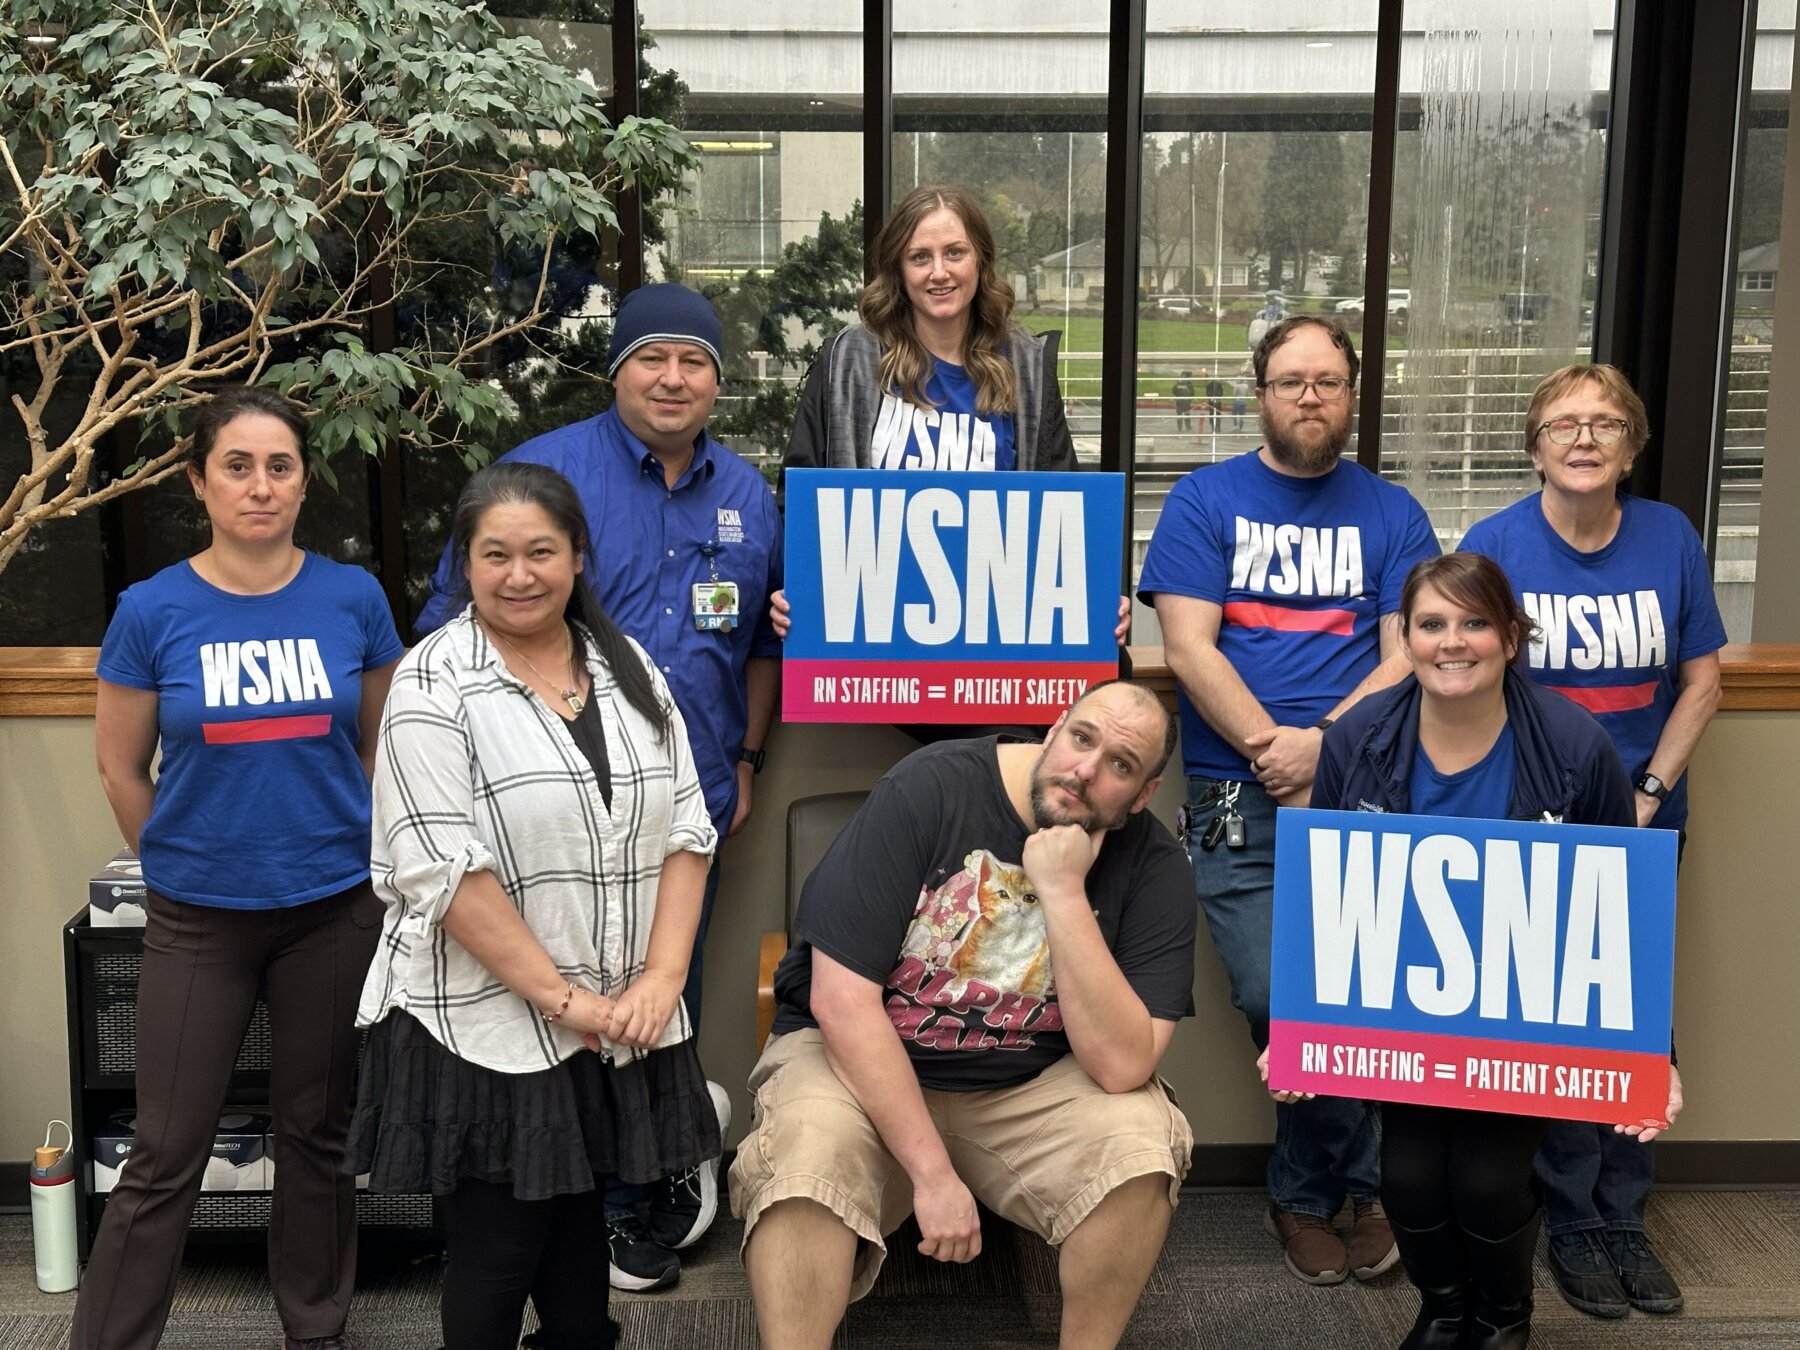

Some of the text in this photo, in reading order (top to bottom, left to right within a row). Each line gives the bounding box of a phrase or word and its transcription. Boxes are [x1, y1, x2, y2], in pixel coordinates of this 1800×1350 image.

[871, 394, 996, 471] WSNA
[717, 507, 742, 526] WSNA
[816, 487, 1090, 645] WSNA
[1231, 515, 1363, 597] WSNA
[1522, 589, 1667, 670] WSNA
[200, 638, 333, 707] WSNA
[813, 676, 837, 703] RN
[840, 676, 921, 704] STAFFING
[953, 678, 1023, 705] PATIENT
[1025, 678, 1088, 705] SAFETY
[1309, 828, 1634, 1031] WSNA
[886, 955, 1064, 1035] ALPHA
[1301, 1041, 1328, 1074] RN
[1331, 1044, 1426, 1083] STAFFING
[1465, 1056, 1550, 1095] PATIENT
[1554, 1065, 1632, 1103] SAFETY
